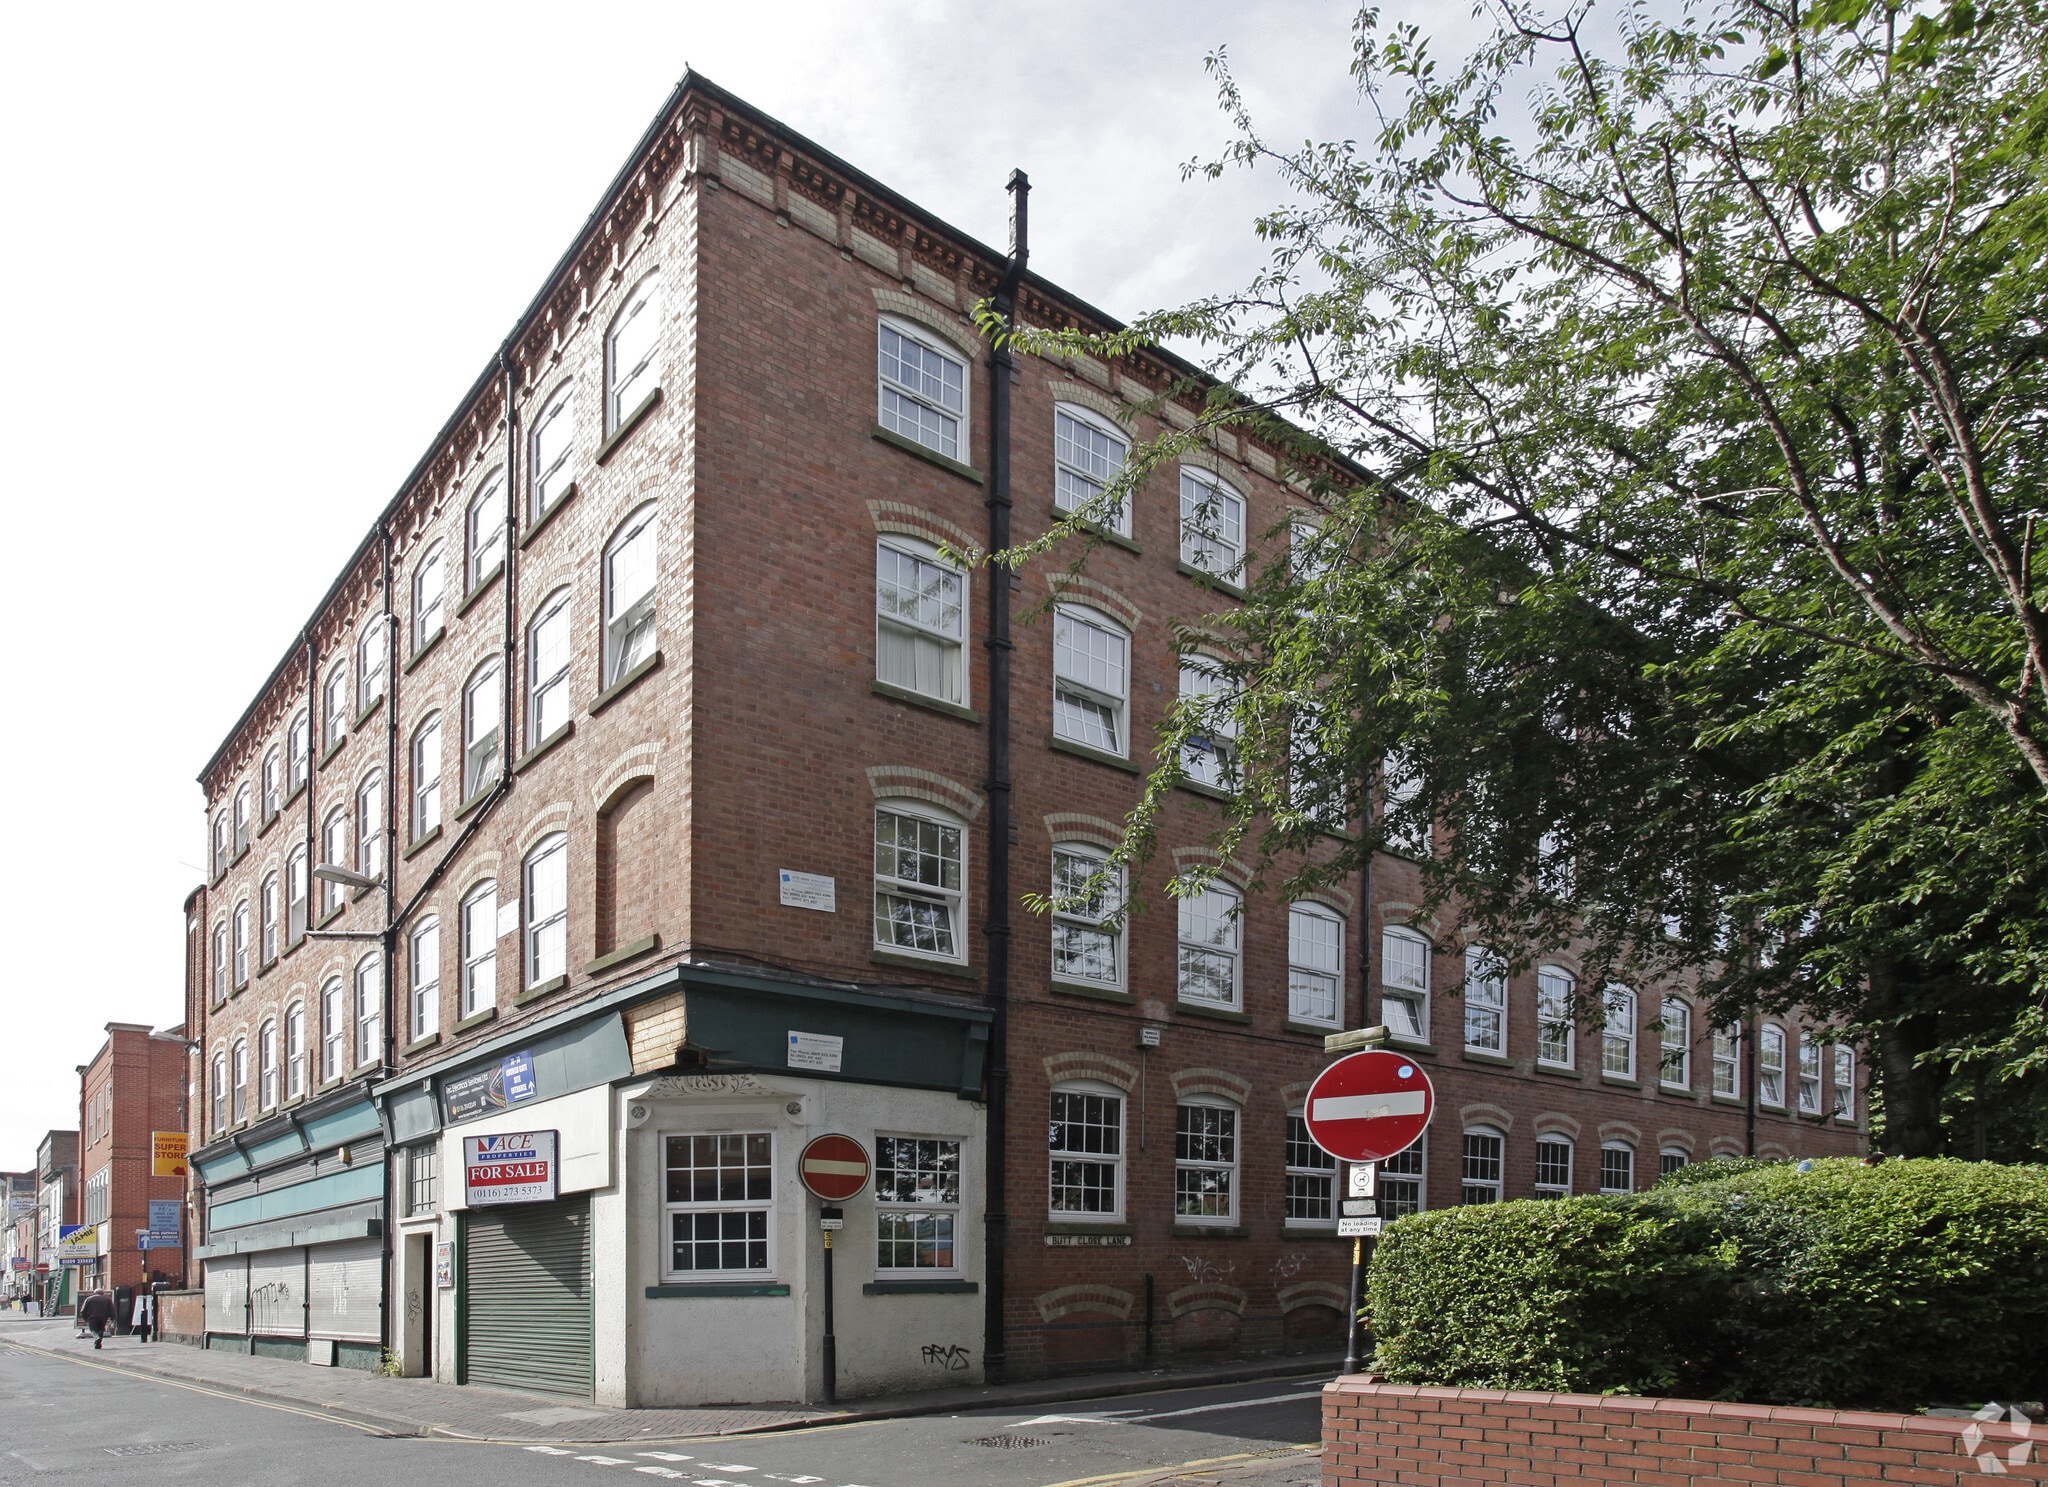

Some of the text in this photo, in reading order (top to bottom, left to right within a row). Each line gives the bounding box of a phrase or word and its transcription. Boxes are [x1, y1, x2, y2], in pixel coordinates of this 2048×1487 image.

[493, 1133, 534, 1151] ACE
[155, 1143, 187, 1151] SUPER
[155, 1151, 187, 1159] STORE
[481, 1151, 533, 1160] PROPERTIES
[471, 1163, 546, 1180] FOR SALE
[473, 1185, 543, 1199] (0116) 273 5373
[1353, 1220, 1378, 1228] loading
[70, 1228, 95, 1245] JAMIE
[1052, 1236, 1126, 1245] BUTT CLOSE LANE
